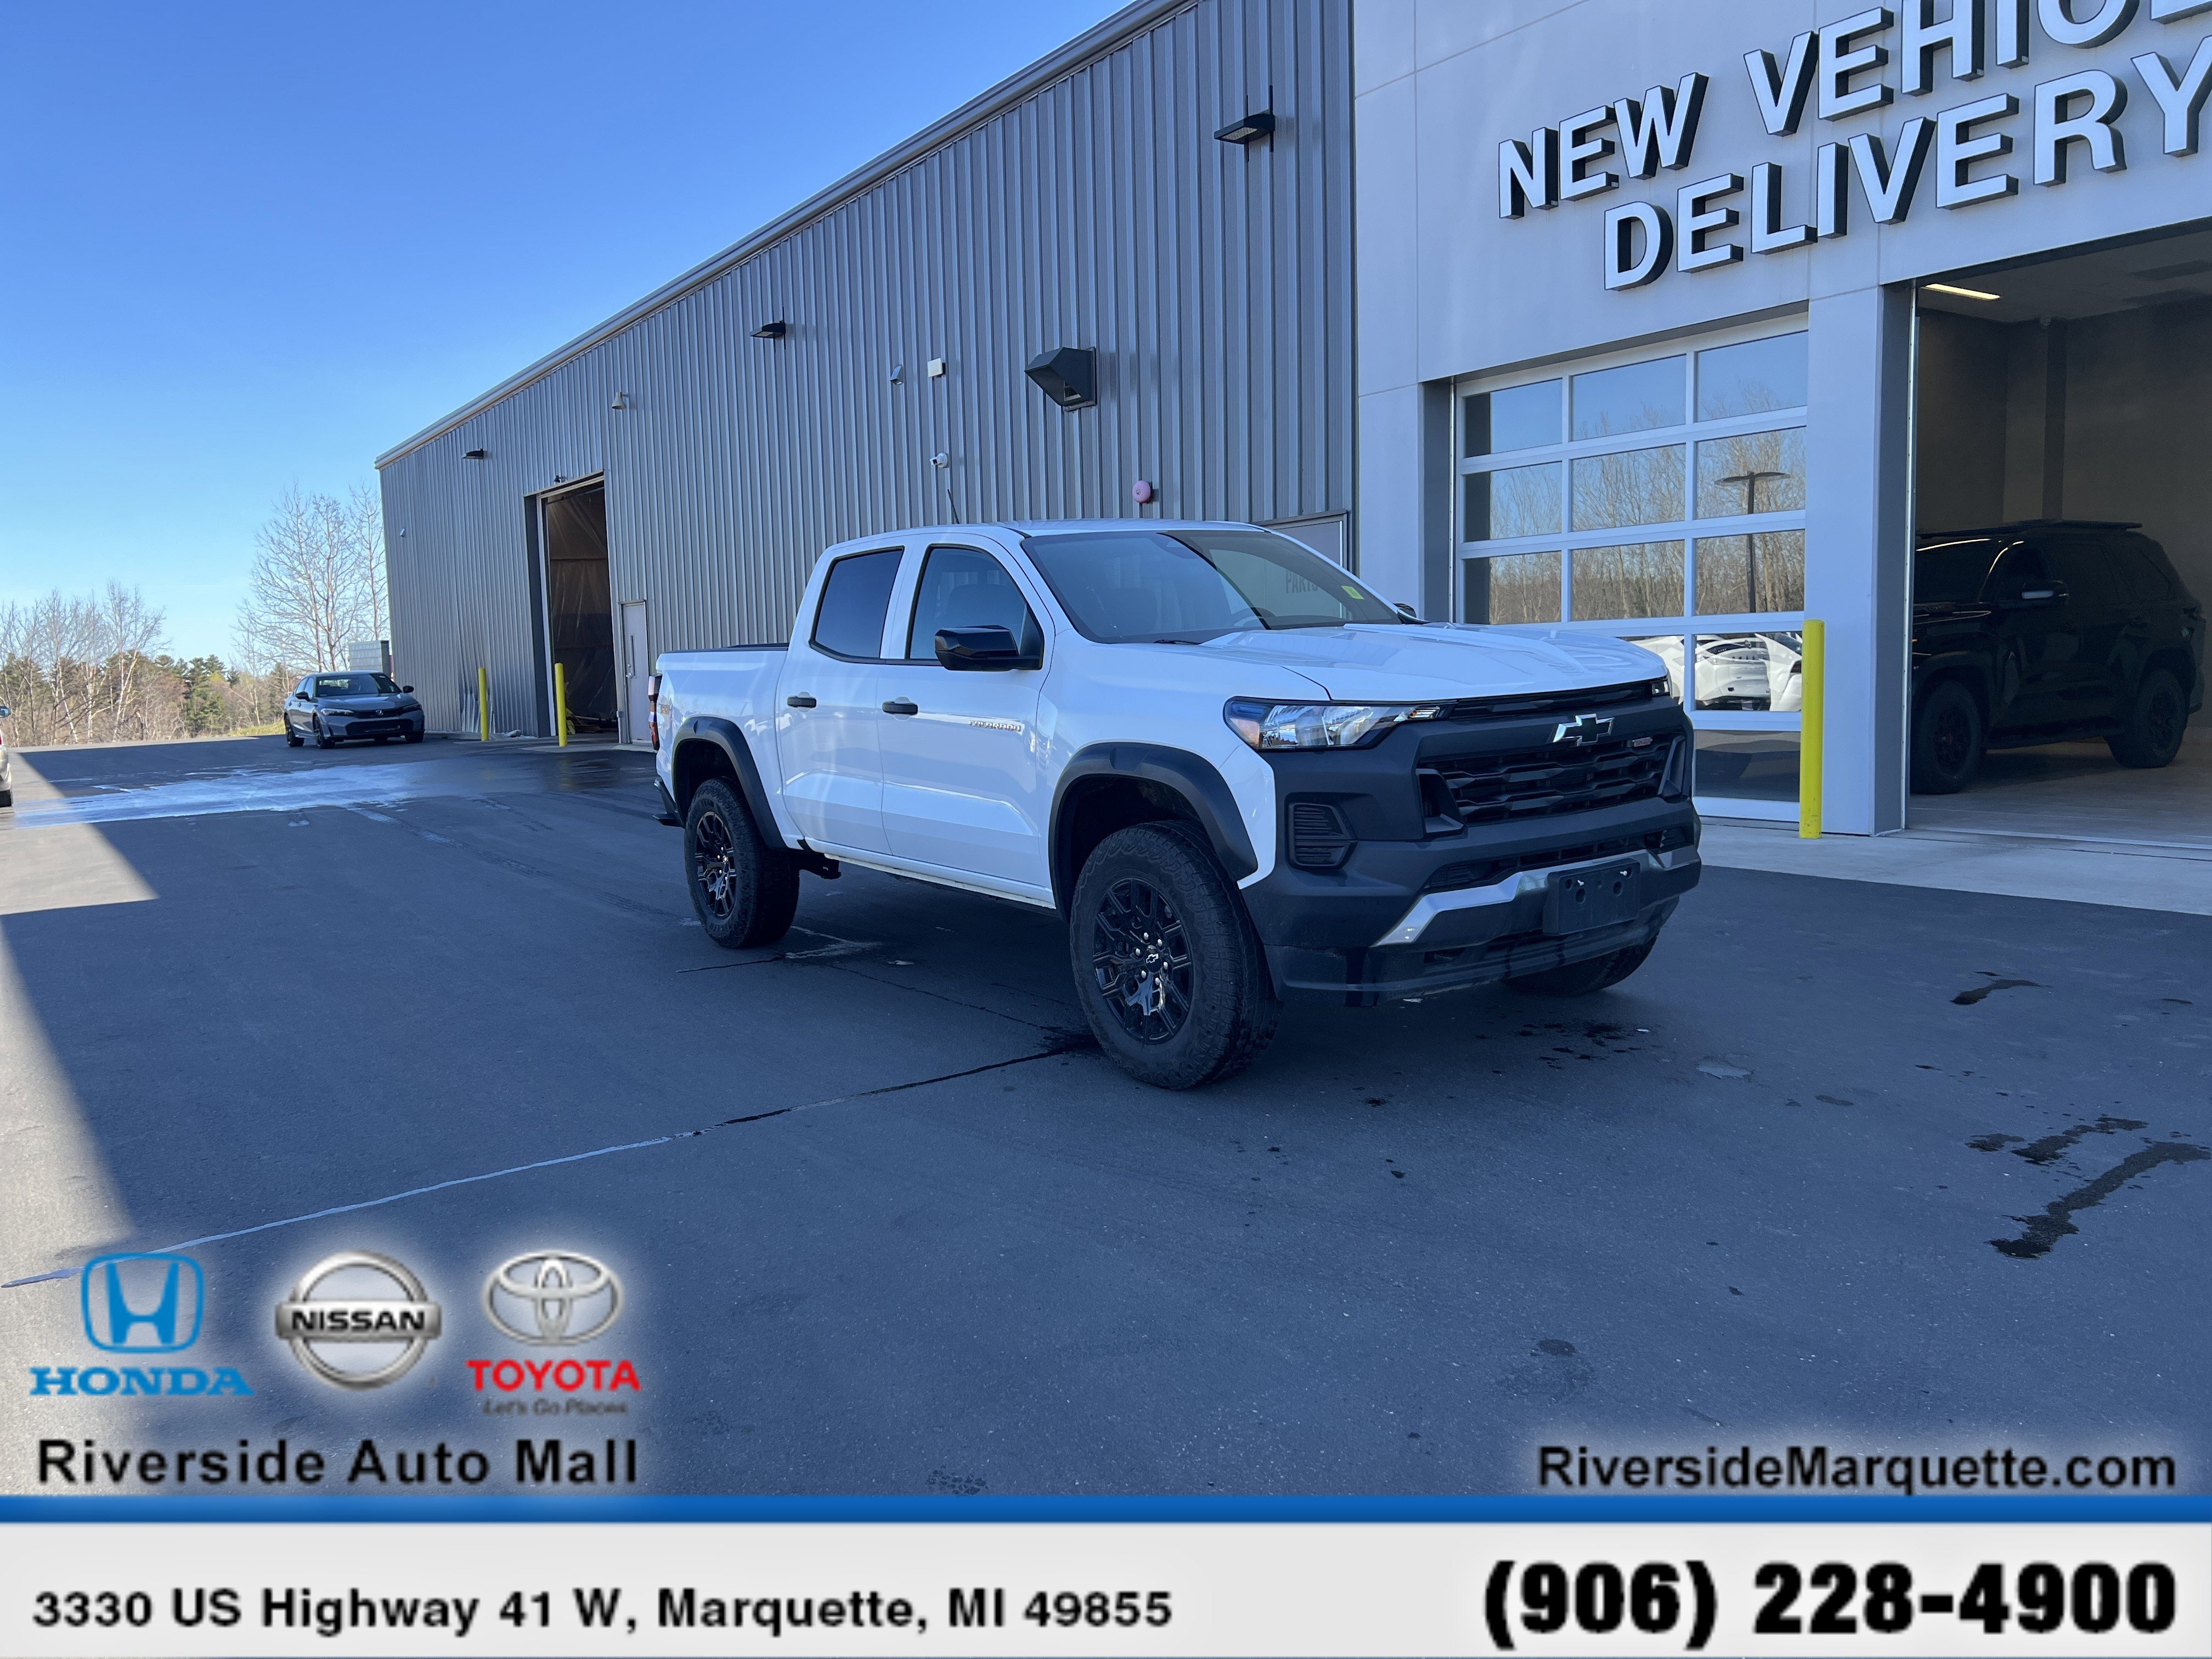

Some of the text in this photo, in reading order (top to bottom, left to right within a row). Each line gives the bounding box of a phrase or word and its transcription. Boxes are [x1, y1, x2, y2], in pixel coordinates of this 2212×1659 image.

[1499, 0, 2212, 219] NEW VEHI
[1604, 34, 2212, 290] DELIVERY
